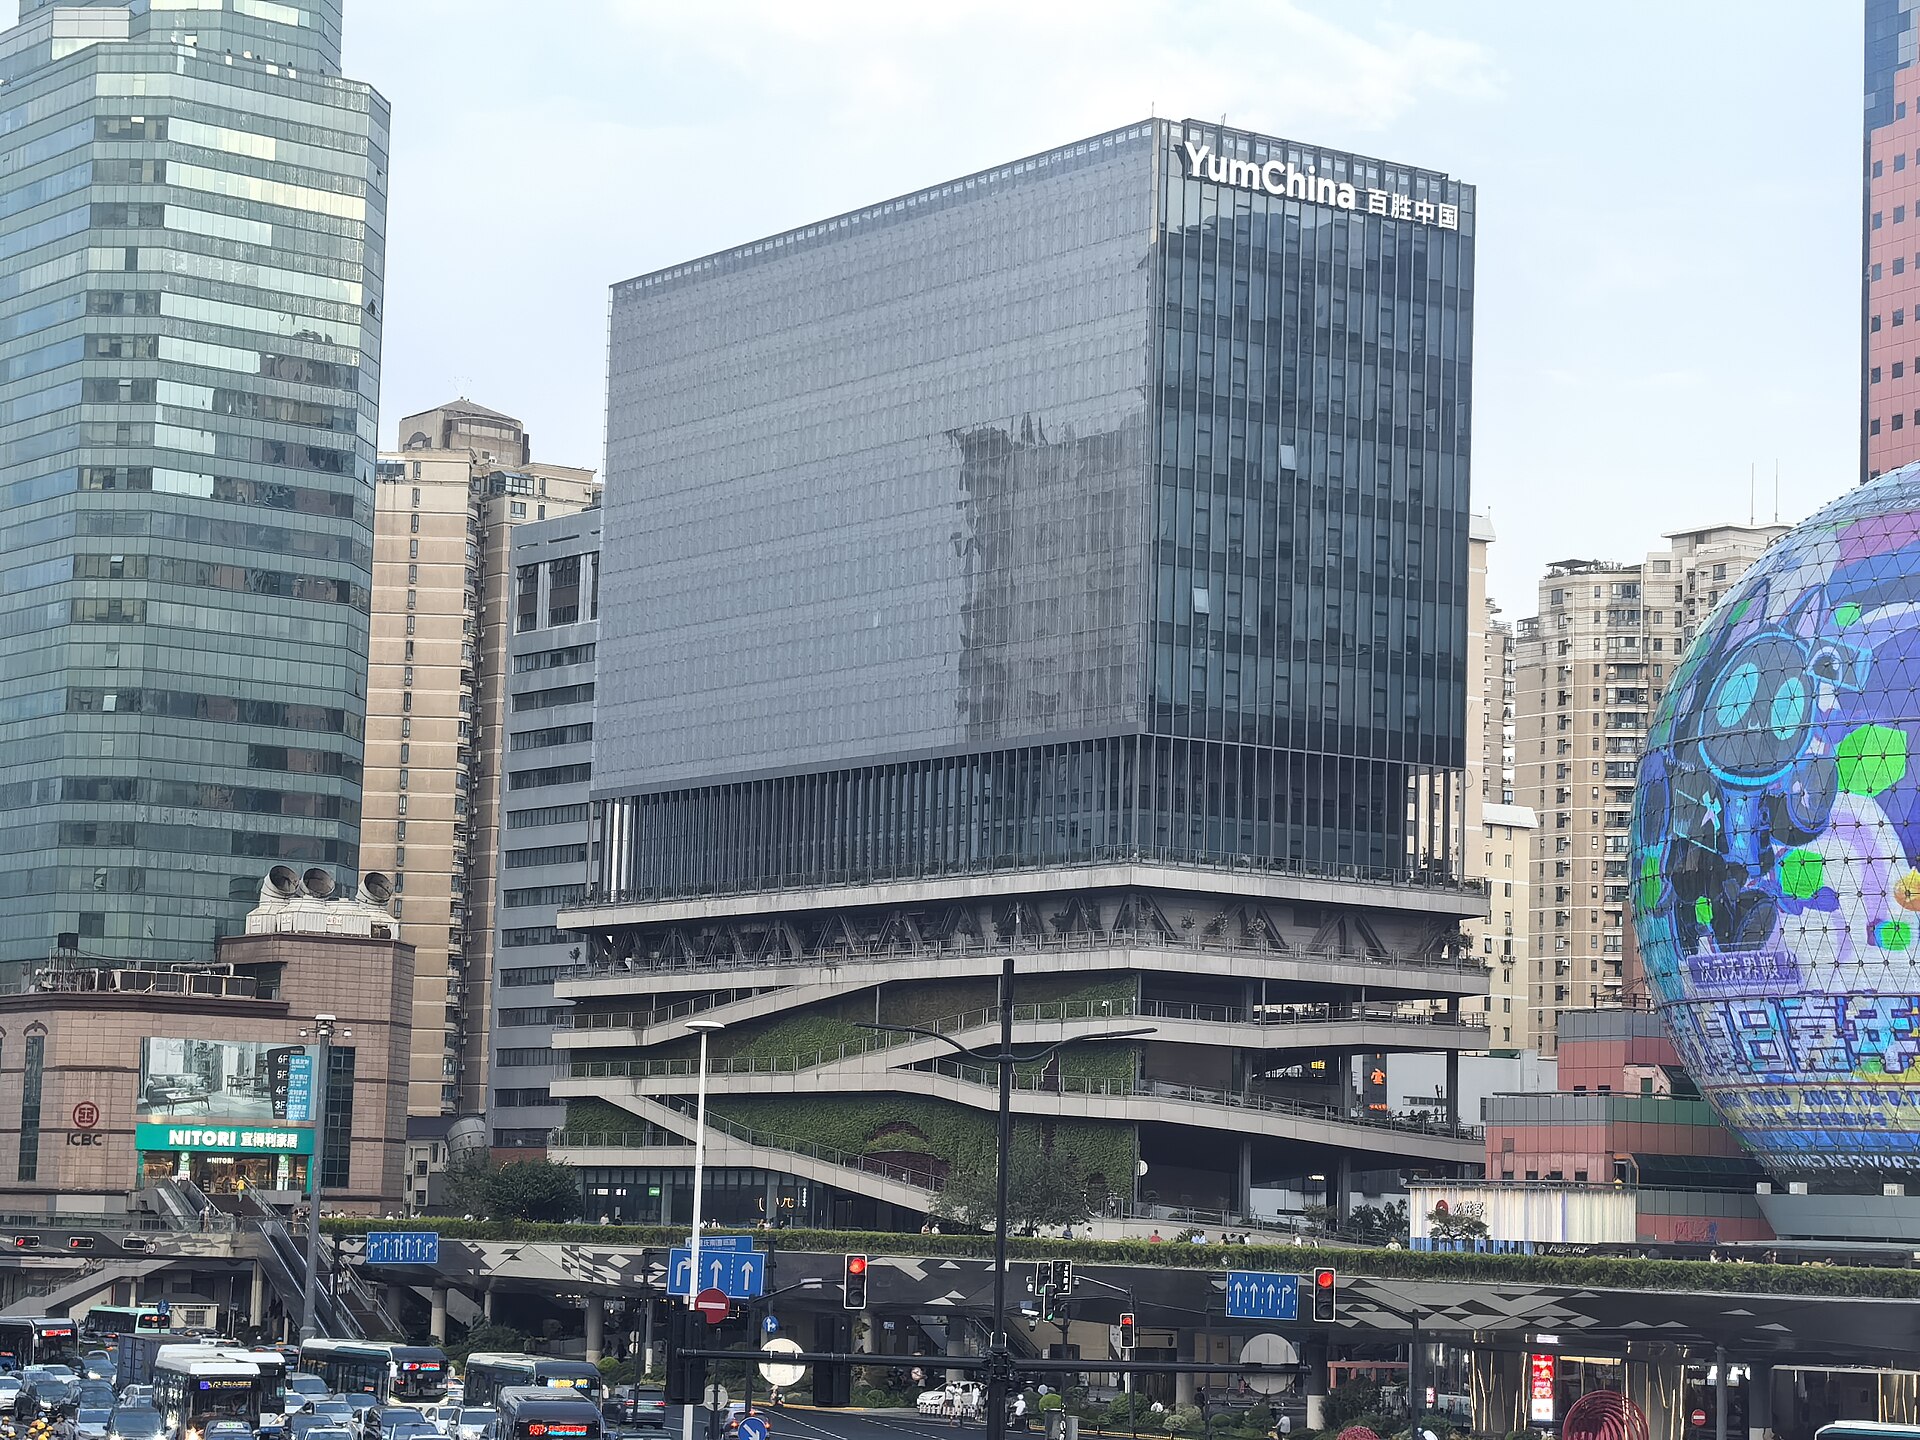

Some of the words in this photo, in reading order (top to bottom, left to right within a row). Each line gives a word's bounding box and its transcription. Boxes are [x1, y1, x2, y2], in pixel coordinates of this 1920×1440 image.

[1184, 141, 1357, 211] YumChina
[1367, 186, 1459, 232] 百胜中国
[66, 1132, 103, 1146] ICBC
[168, 1129, 236, 1147] NITORI
[240, 1132, 299, 1149] 宜得利家居
[211, 1157, 234, 1165] NITORI
